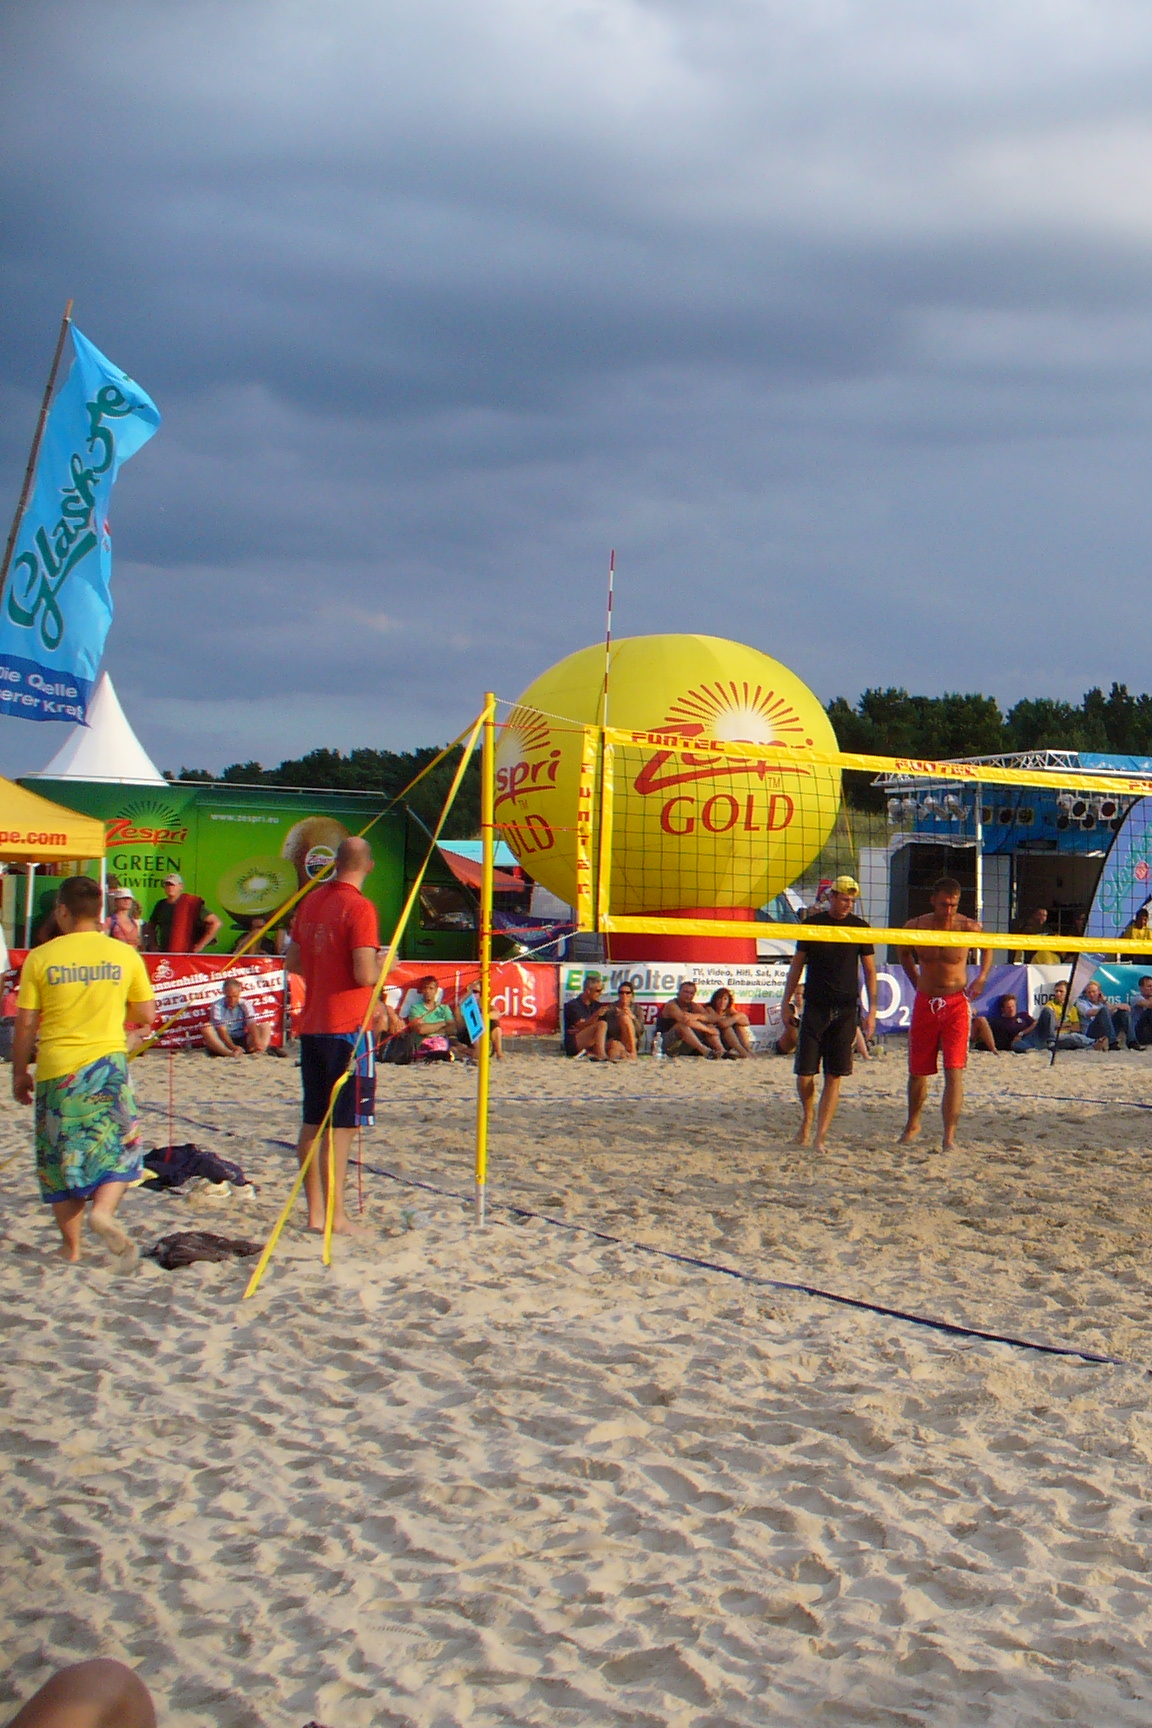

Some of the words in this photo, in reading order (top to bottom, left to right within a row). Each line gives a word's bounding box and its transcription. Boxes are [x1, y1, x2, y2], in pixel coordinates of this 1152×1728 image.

[660, 793, 794, 835] GOLD
[105, 818, 188, 847] Zespri
[113, 854, 181, 872] GREEN
[46, 960, 122, 986] Chiquita
